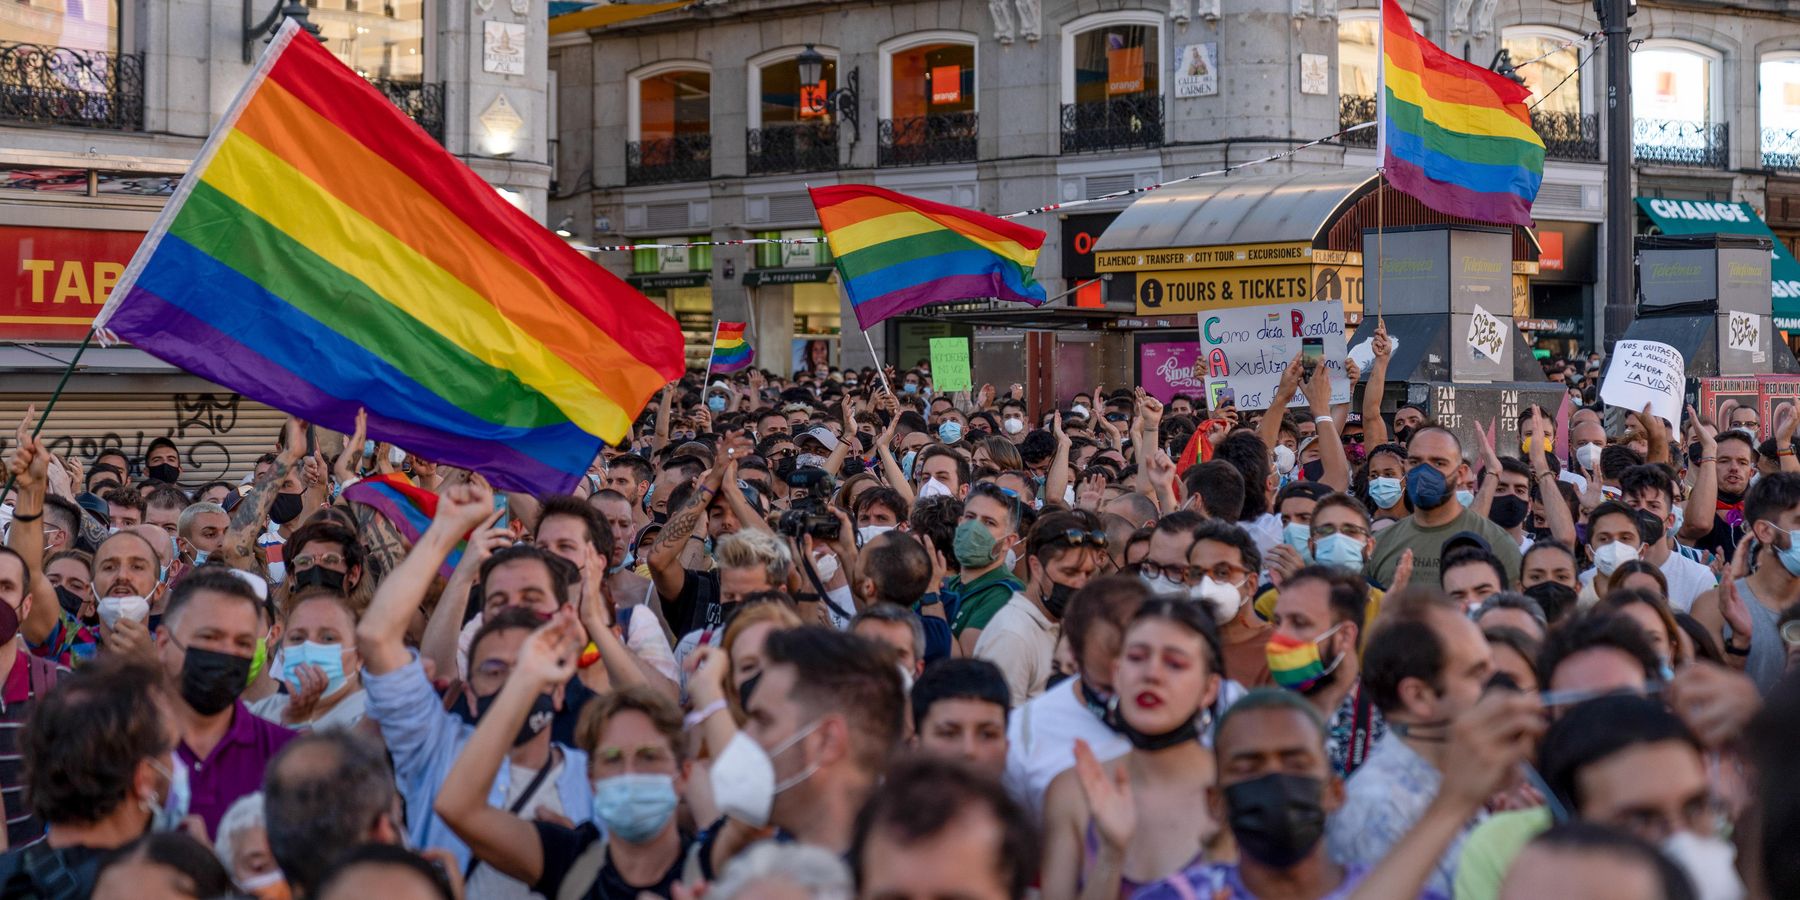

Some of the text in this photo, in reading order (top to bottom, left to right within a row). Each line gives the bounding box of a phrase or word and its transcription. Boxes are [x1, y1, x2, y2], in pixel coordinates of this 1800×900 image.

[1110, 80, 1141, 90] orange
[1180, 83, 1212, 95] CARMEN
[933, 91, 958, 101] orange
[1650, 198, 1750, 223] CHANGE
[1098, 247, 1302, 267] FLAMENCO TRANSFER CITY TOUR EXCURSIONES
[1166, 277, 1307, 302] TOURS & TICKETS
[1204, 316, 1250, 345] Como
[1620, 342, 1638, 350] NOS
[1209, 347, 1230, 377] A
[1624, 359, 1631, 367] Y
[1632, 361, 1664, 376] AHORA
[1627, 371, 1672, 393] LA VIDA
[1710, 380, 1722, 391] RED
[1723, 380, 1740, 391] KIRIN
[1438, 386, 1456, 400] FAN
[1765, 383, 1777, 395] RED
[1778, 383, 1795, 395] KIRIN
[1240, 391, 1262, 408] así
[1501, 390, 1518, 403] FAN
[1438, 401, 1456, 414] FAN
[1501, 404, 1518, 417] FAN
